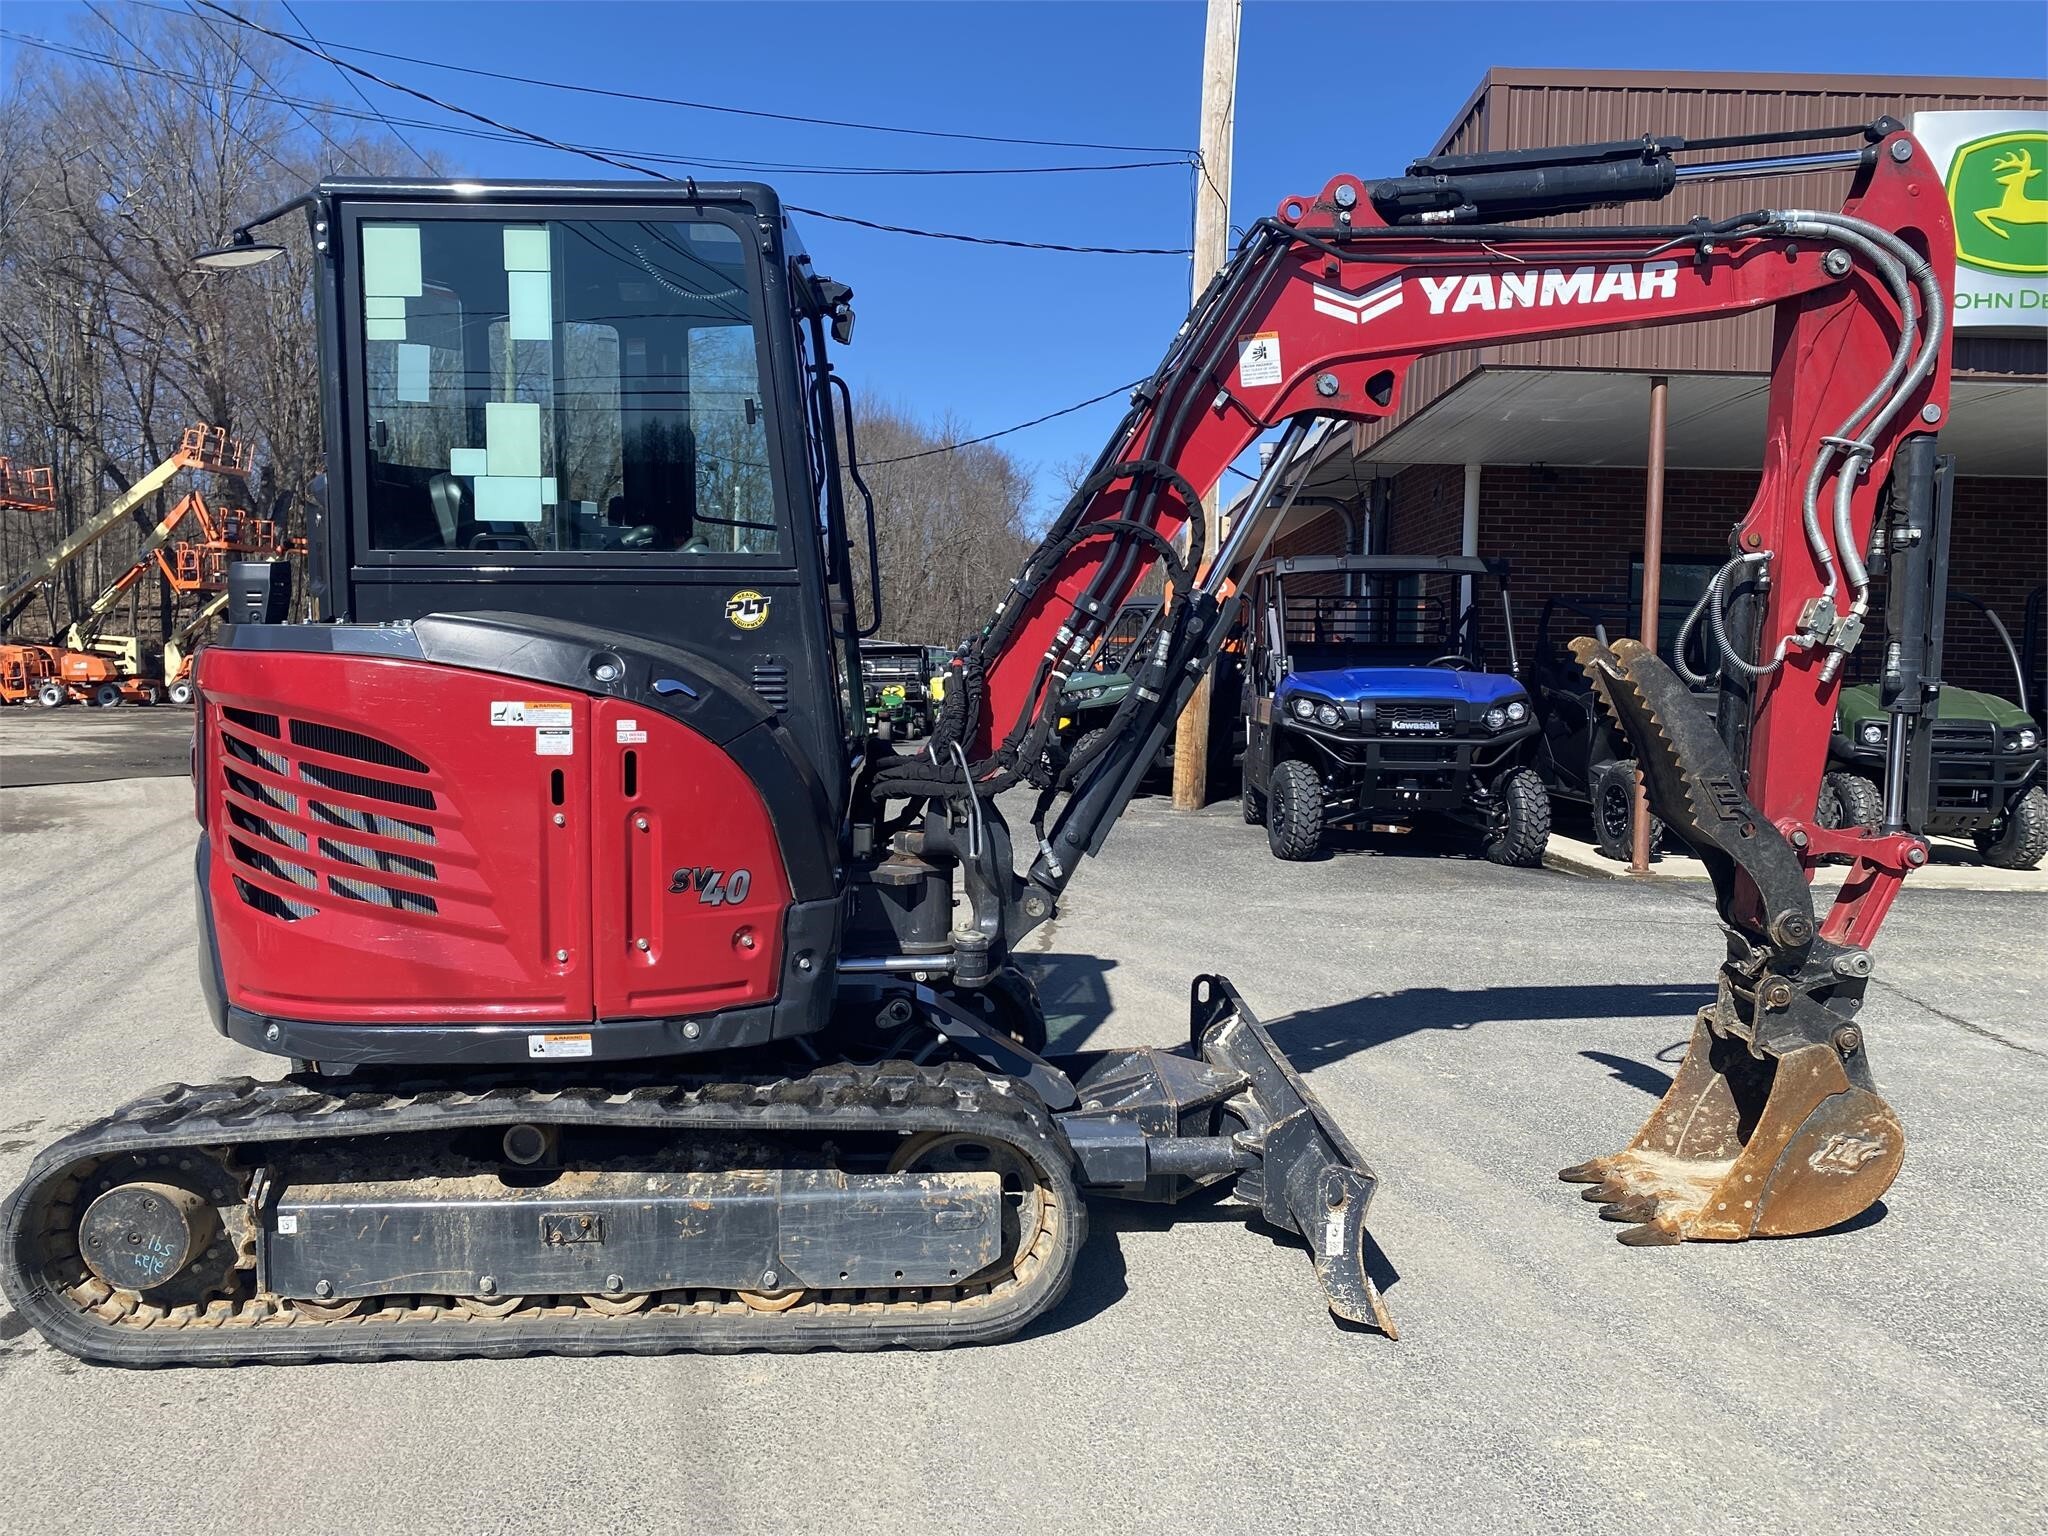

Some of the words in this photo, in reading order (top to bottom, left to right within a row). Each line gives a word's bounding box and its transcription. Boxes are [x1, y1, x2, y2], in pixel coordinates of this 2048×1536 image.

[1417, 260, 1679, 315] YANMAR
[1953, 292, 2013, 309] OHN
[725, 596, 772, 619] PLT
[733, 615, 765, 628] EQUIPMENT
[1391, 720, 1440, 730] Kawasaki
[667, 865, 752, 907] SV40
